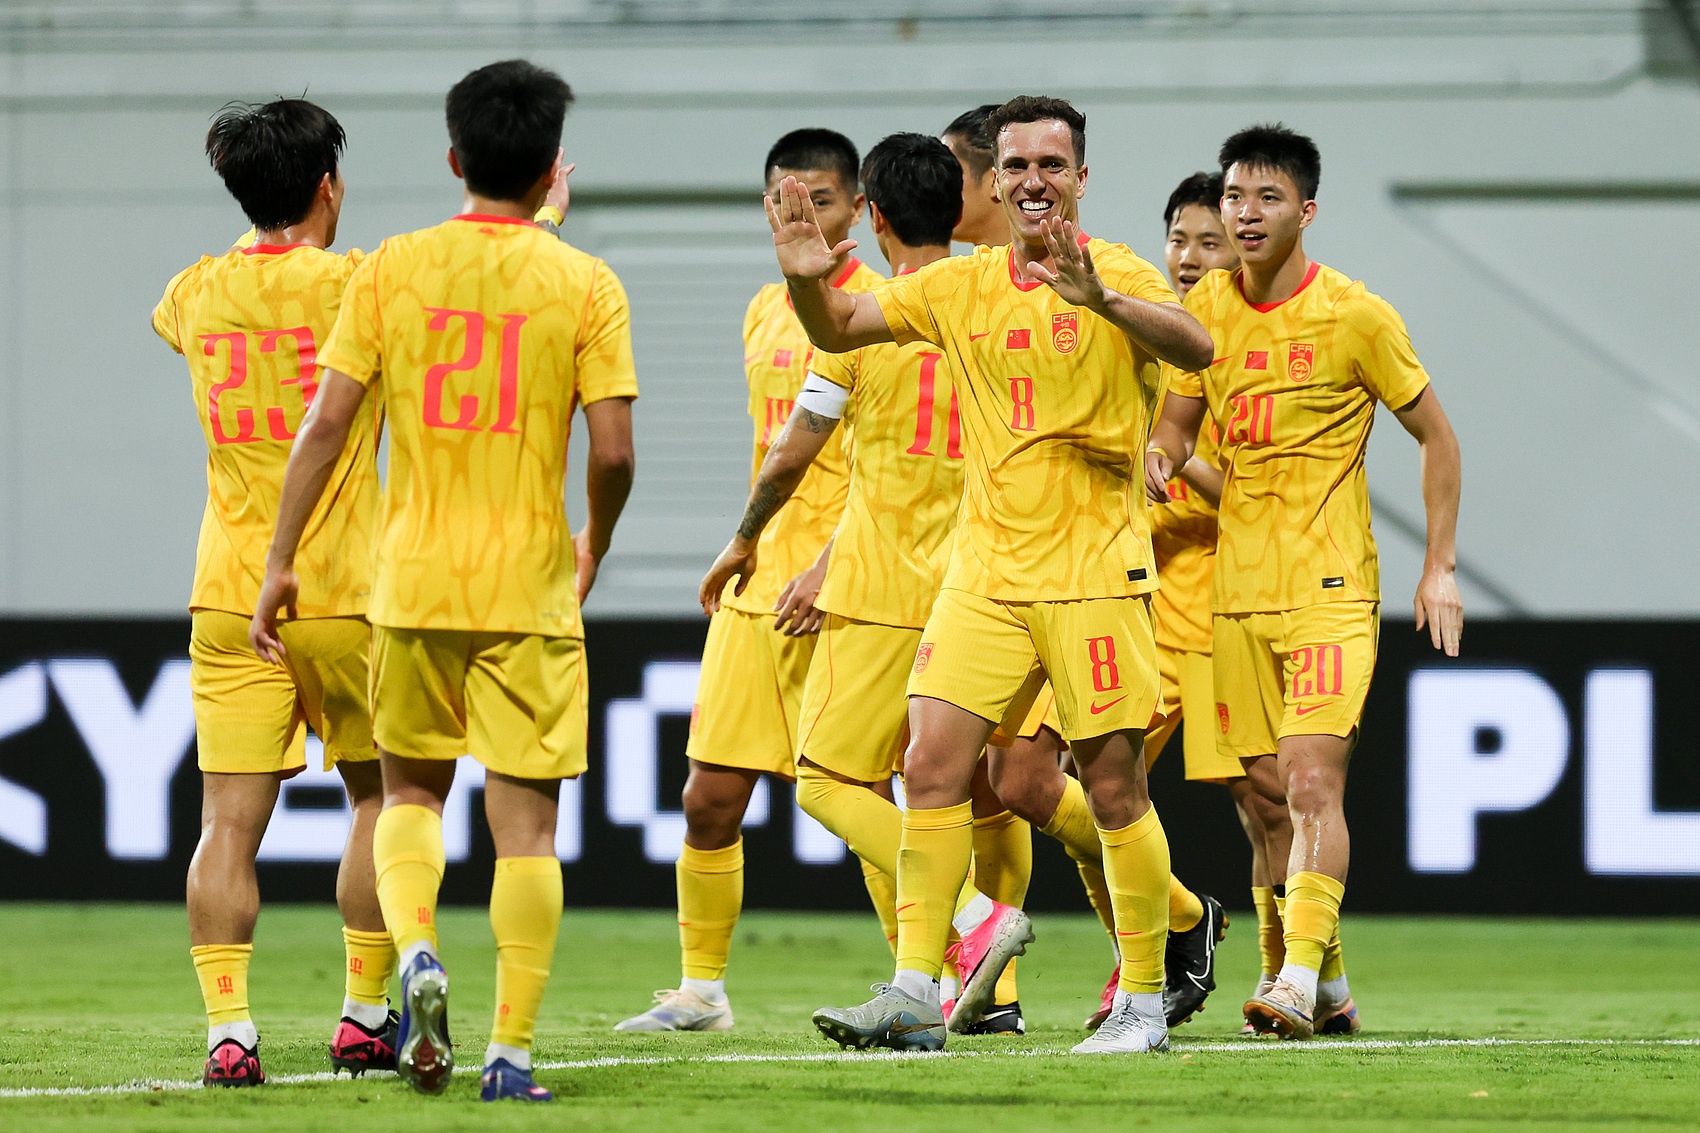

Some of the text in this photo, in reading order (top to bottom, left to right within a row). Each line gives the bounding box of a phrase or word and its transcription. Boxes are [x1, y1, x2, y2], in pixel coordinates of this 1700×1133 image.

[1053, 313, 1076, 323] CFA
[424, 306, 529, 435] 21
[1290, 344, 1313, 353] CFA
[196, 326, 319, 444] 23
[1008, 377, 1036, 431] 8
[1228, 394, 1276, 445] 20
[1084, 635, 1123, 692] 8
[1289, 644, 1345, 698] 20
